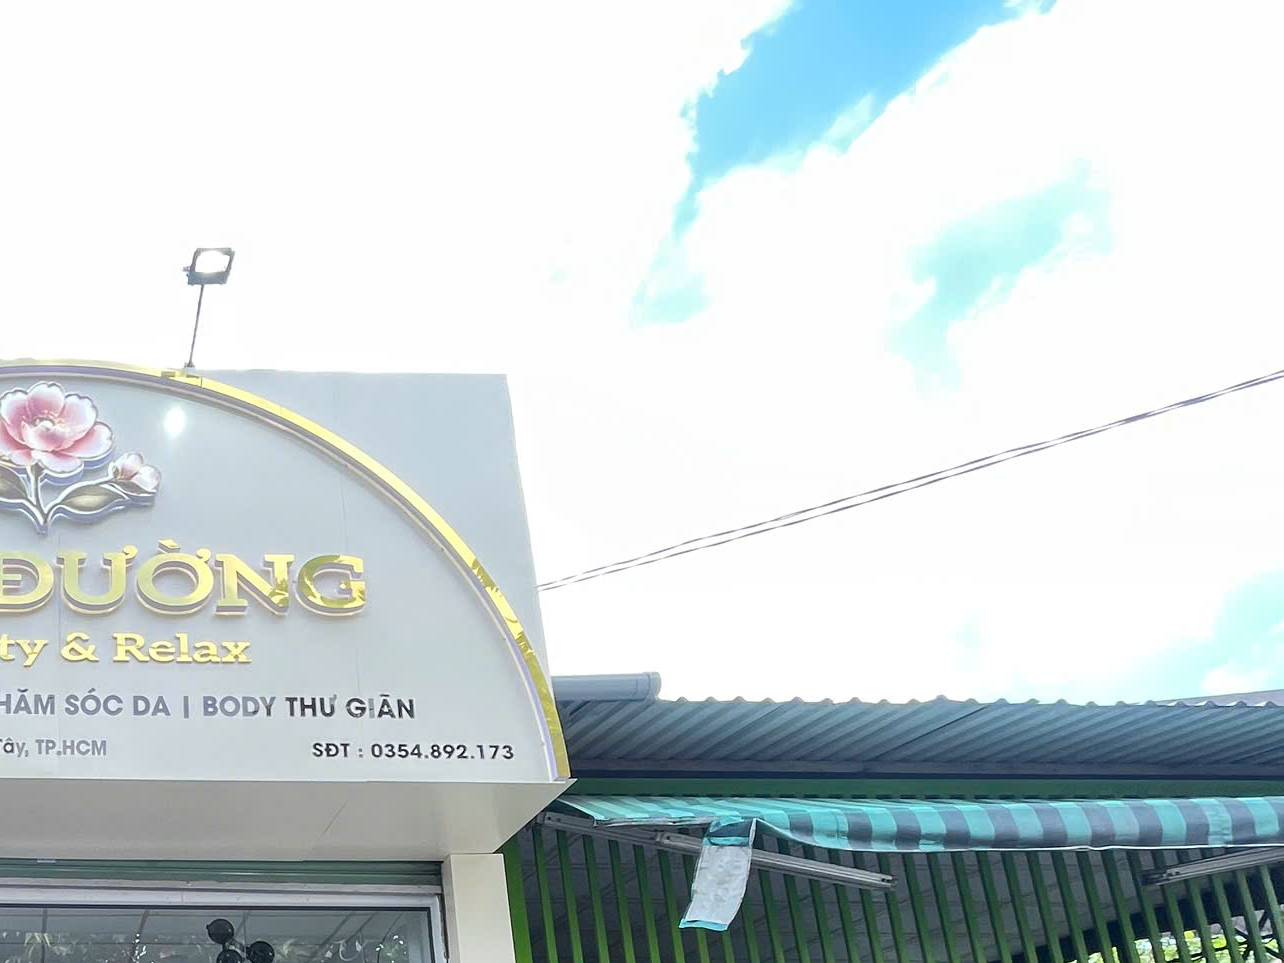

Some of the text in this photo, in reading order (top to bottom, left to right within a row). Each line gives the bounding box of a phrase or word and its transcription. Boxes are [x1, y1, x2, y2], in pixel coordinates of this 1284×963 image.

[60, 632, 100, 662] &
[112, 632, 252, 662] Relax
[64, 688, 124, 716] SÓC
[132, 695, 171, 717] DA
[202, 695, 277, 718] BODY
[285, 694, 338, 718] THƯ
[345, 694, 416, 719] GIÃN
[36, 739, 107, 756] TP.HCM
[312, 743, 350, 758] SĐT
[371, 743, 515, 760] 0354.892.173
